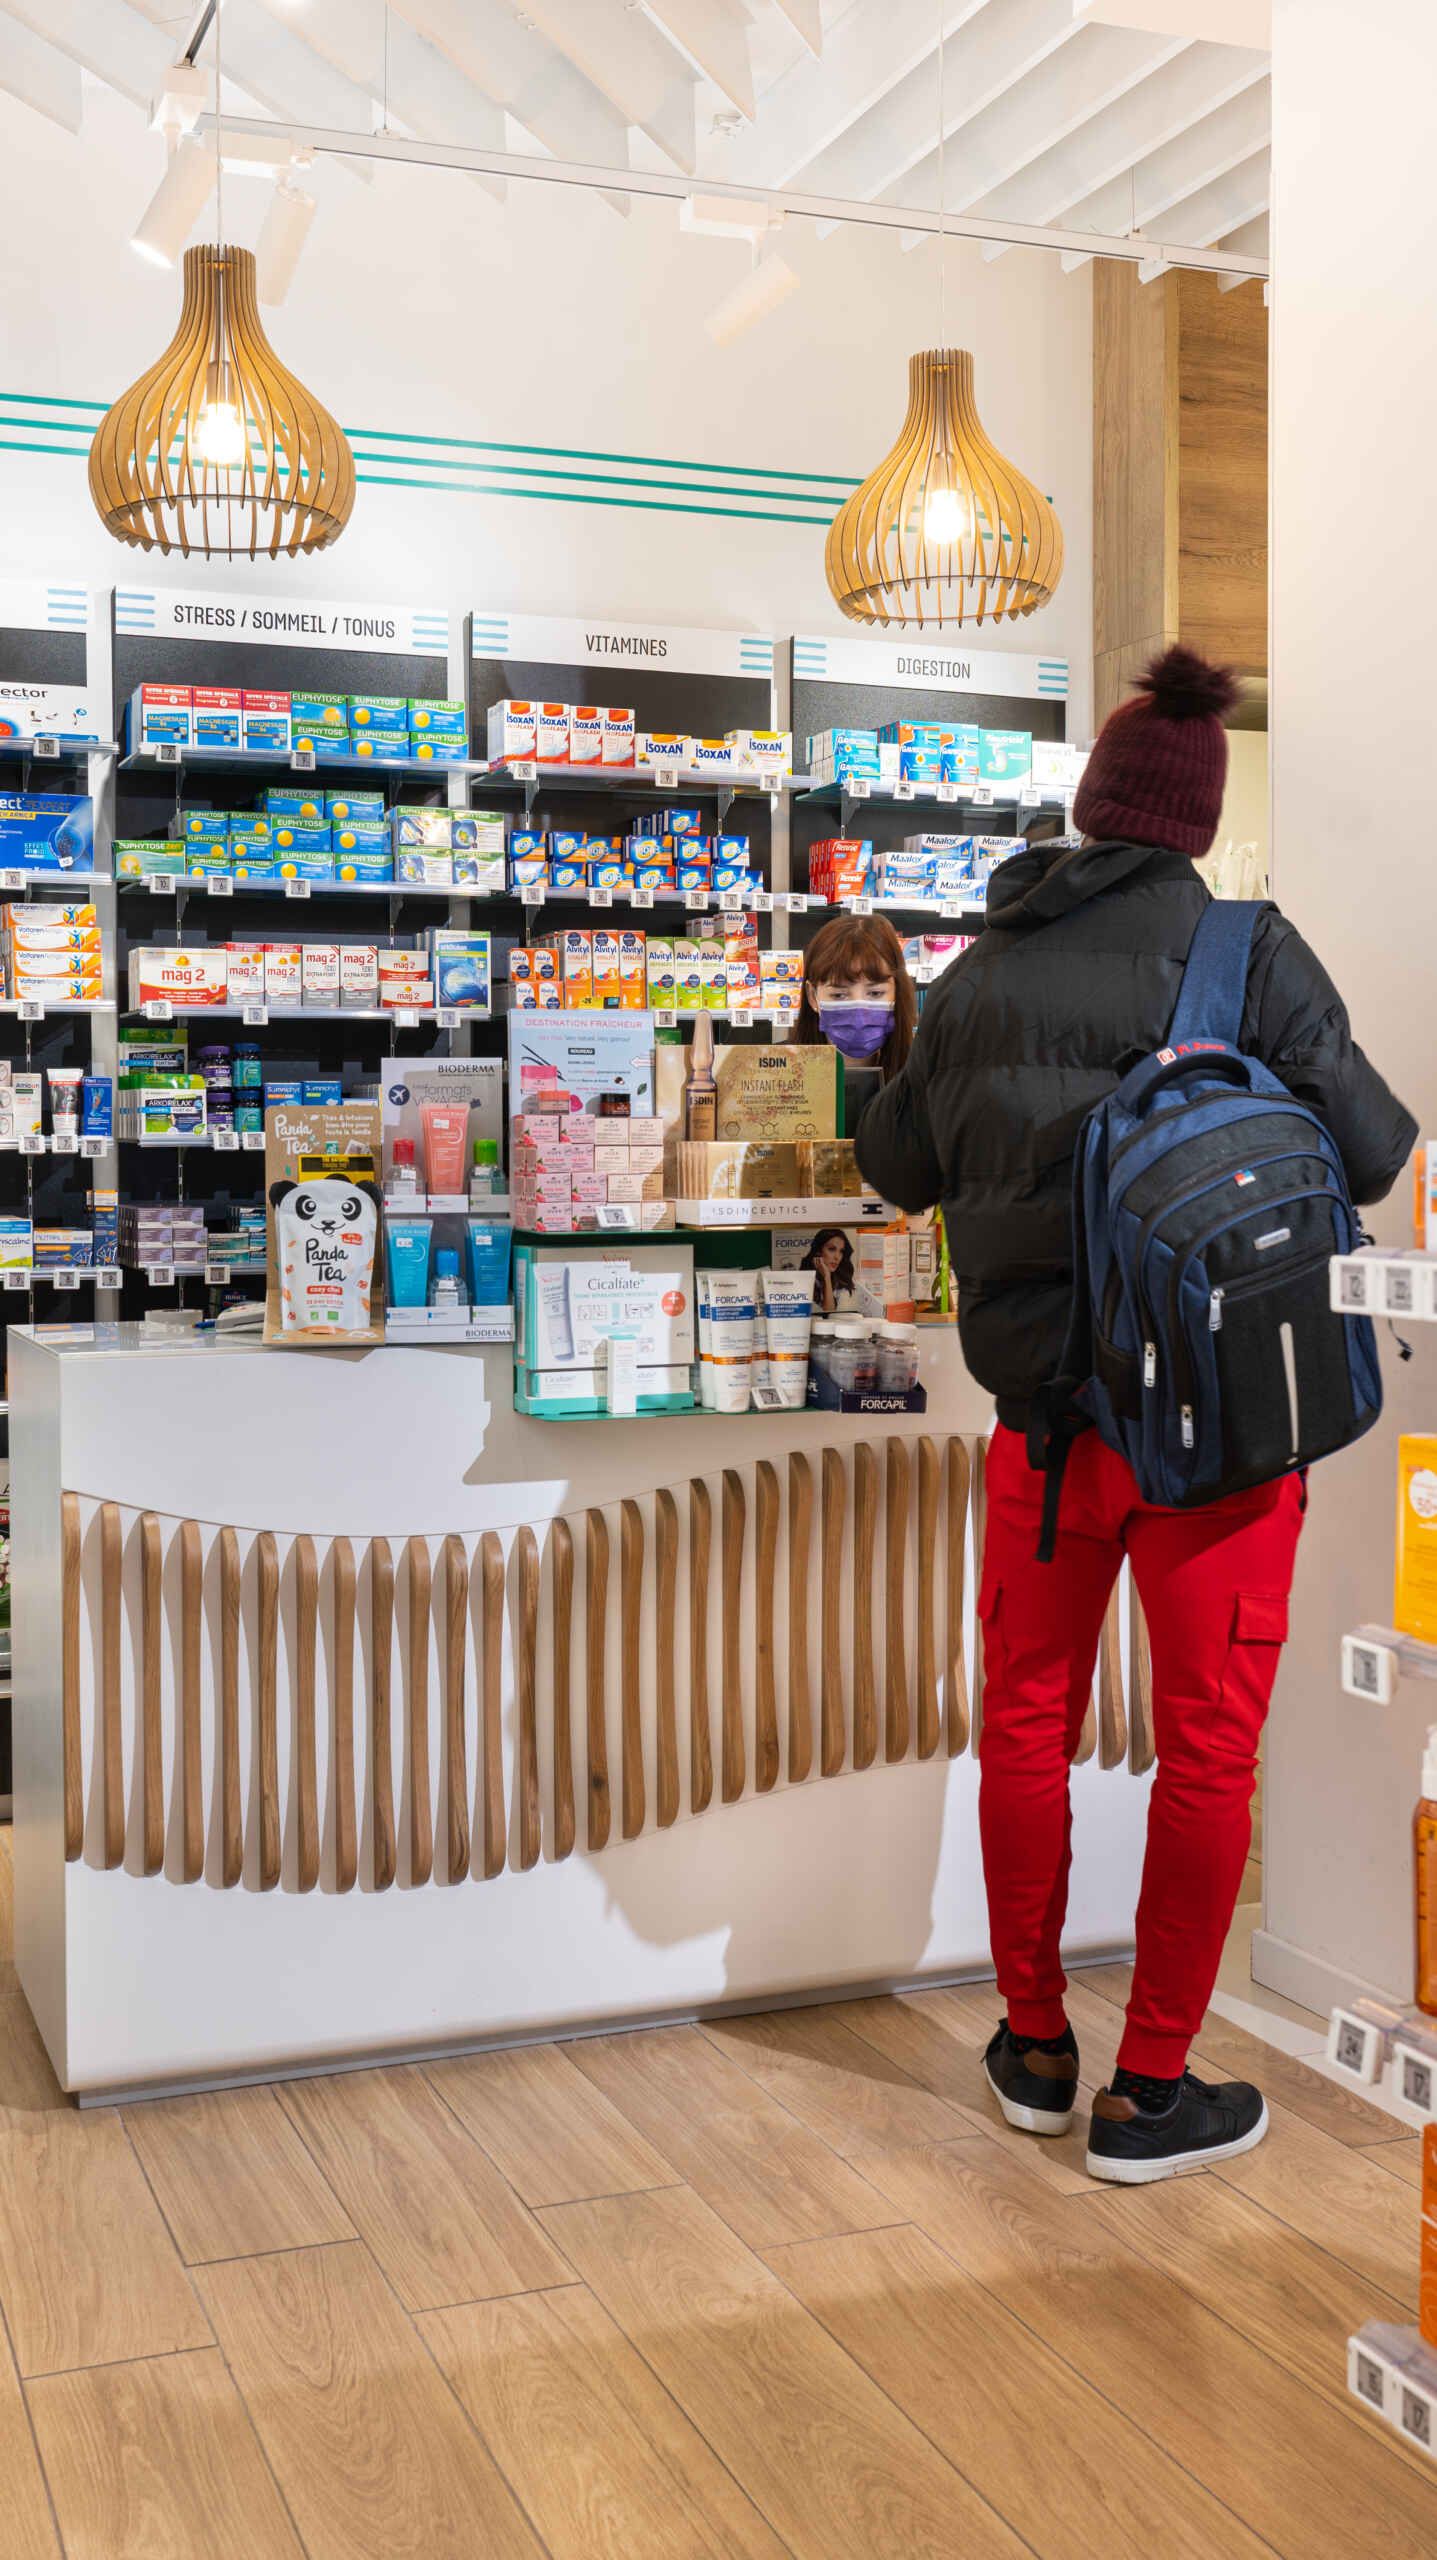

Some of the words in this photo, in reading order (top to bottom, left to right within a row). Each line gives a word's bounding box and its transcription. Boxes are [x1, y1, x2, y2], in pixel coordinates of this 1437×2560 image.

[174, 605, 235, 628] STRESS
[240, 609, 247, 628] /
[252, 610, 327, 635] SOMMEIL
[331, 614, 337, 635] /
[343, 617, 396, 639] TONUS
[585, 634, 668, 657] VITAMINES
[896, 657, 972, 680] DIGESTION
[306, 954, 327, 964] mag
[329, 953, 336, 963] 2
[343, 955, 365, 965] mag
[367, 954, 374, 964] 2
[393, 962, 409, 970] mag
[410, 961, 416, 969] 2
[161, 969, 192, 984] mag
[195, 969, 205, 981] 2
[229, 967, 250, 977] mag
[251, 967, 258, 976] 2
[267, 967, 288, 978] mag
[289, 967, 295, 976] 2
[396, 993, 412, 1001] mag
[414, 992, 420, 1000] 2
[759, 1057, 787, 1068] ISDIN
[438, 1064, 495, 1073] BIODERMA
[274, 1114, 313, 1138] Panda
[280, 1136, 313, 1155] Tea
[712, 1206, 808, 1216] ISDINCEUTICS
[775, 1239, 814, 1248] FORCAP
[306, 1238, 350, 1263] Panda
[312, 1263, 347, 1282] Tea
[716, 1295, 753, 1304] FORCAPIL
[769, 1293, 809, 1301] FORCAPIL
[860, 1400, 907, 1409] FORCAPIL
